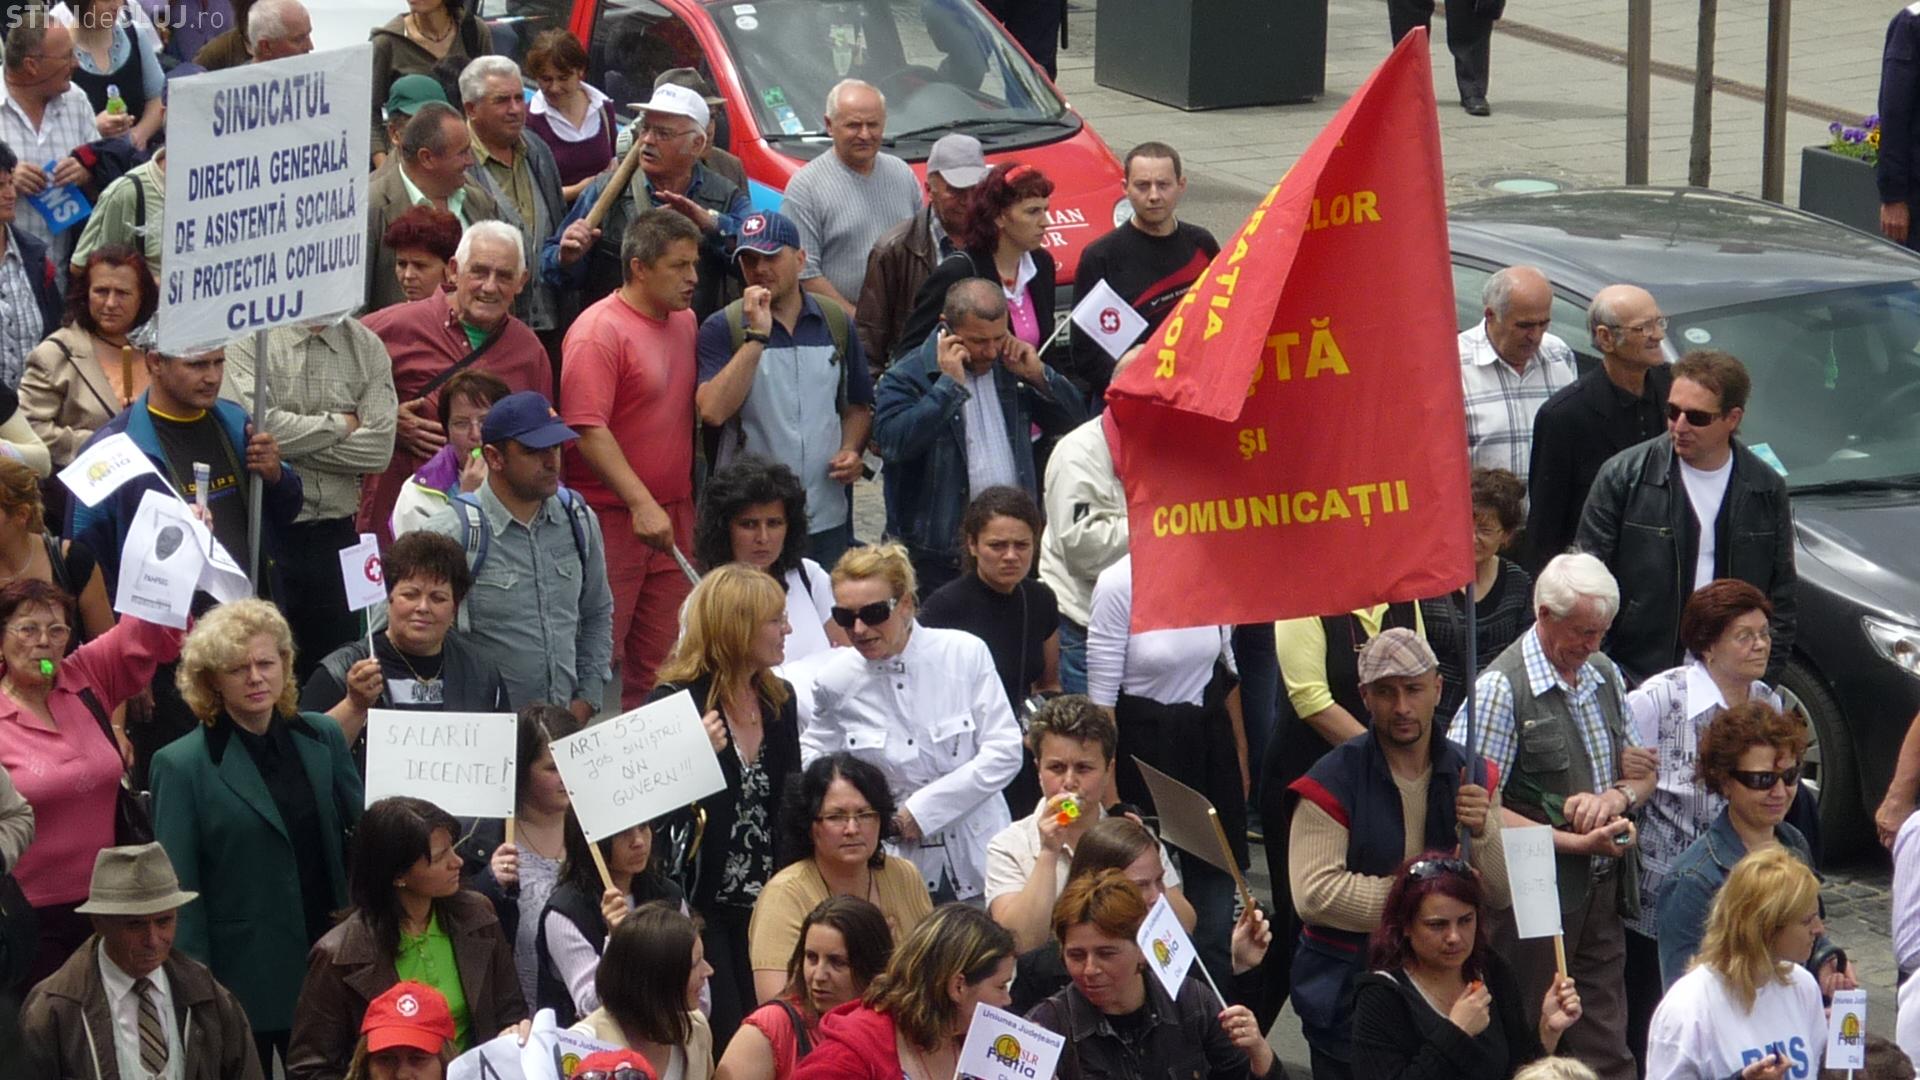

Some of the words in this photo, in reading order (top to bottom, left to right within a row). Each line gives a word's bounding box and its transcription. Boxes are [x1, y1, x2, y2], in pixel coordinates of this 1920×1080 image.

[213, 71, 330, 137] SINDICATUL
[189, 156, 260, 202] DIRECTIA
[1305, 191, 1382, 231] LOR
[175, 219, 196, 254] DE
[168, 271, 183, 305] SI
[192, 252, 277, 300] PROTECTIA
[286, 233, 361, 281] COPILULUI
[227, 290, 303, 331] CLUJ
[386, 722, 480, 748] SALARII
[404, 755, 510, 793] DECENTE!
[982, 1008, 1018, 1030] Uniunea
